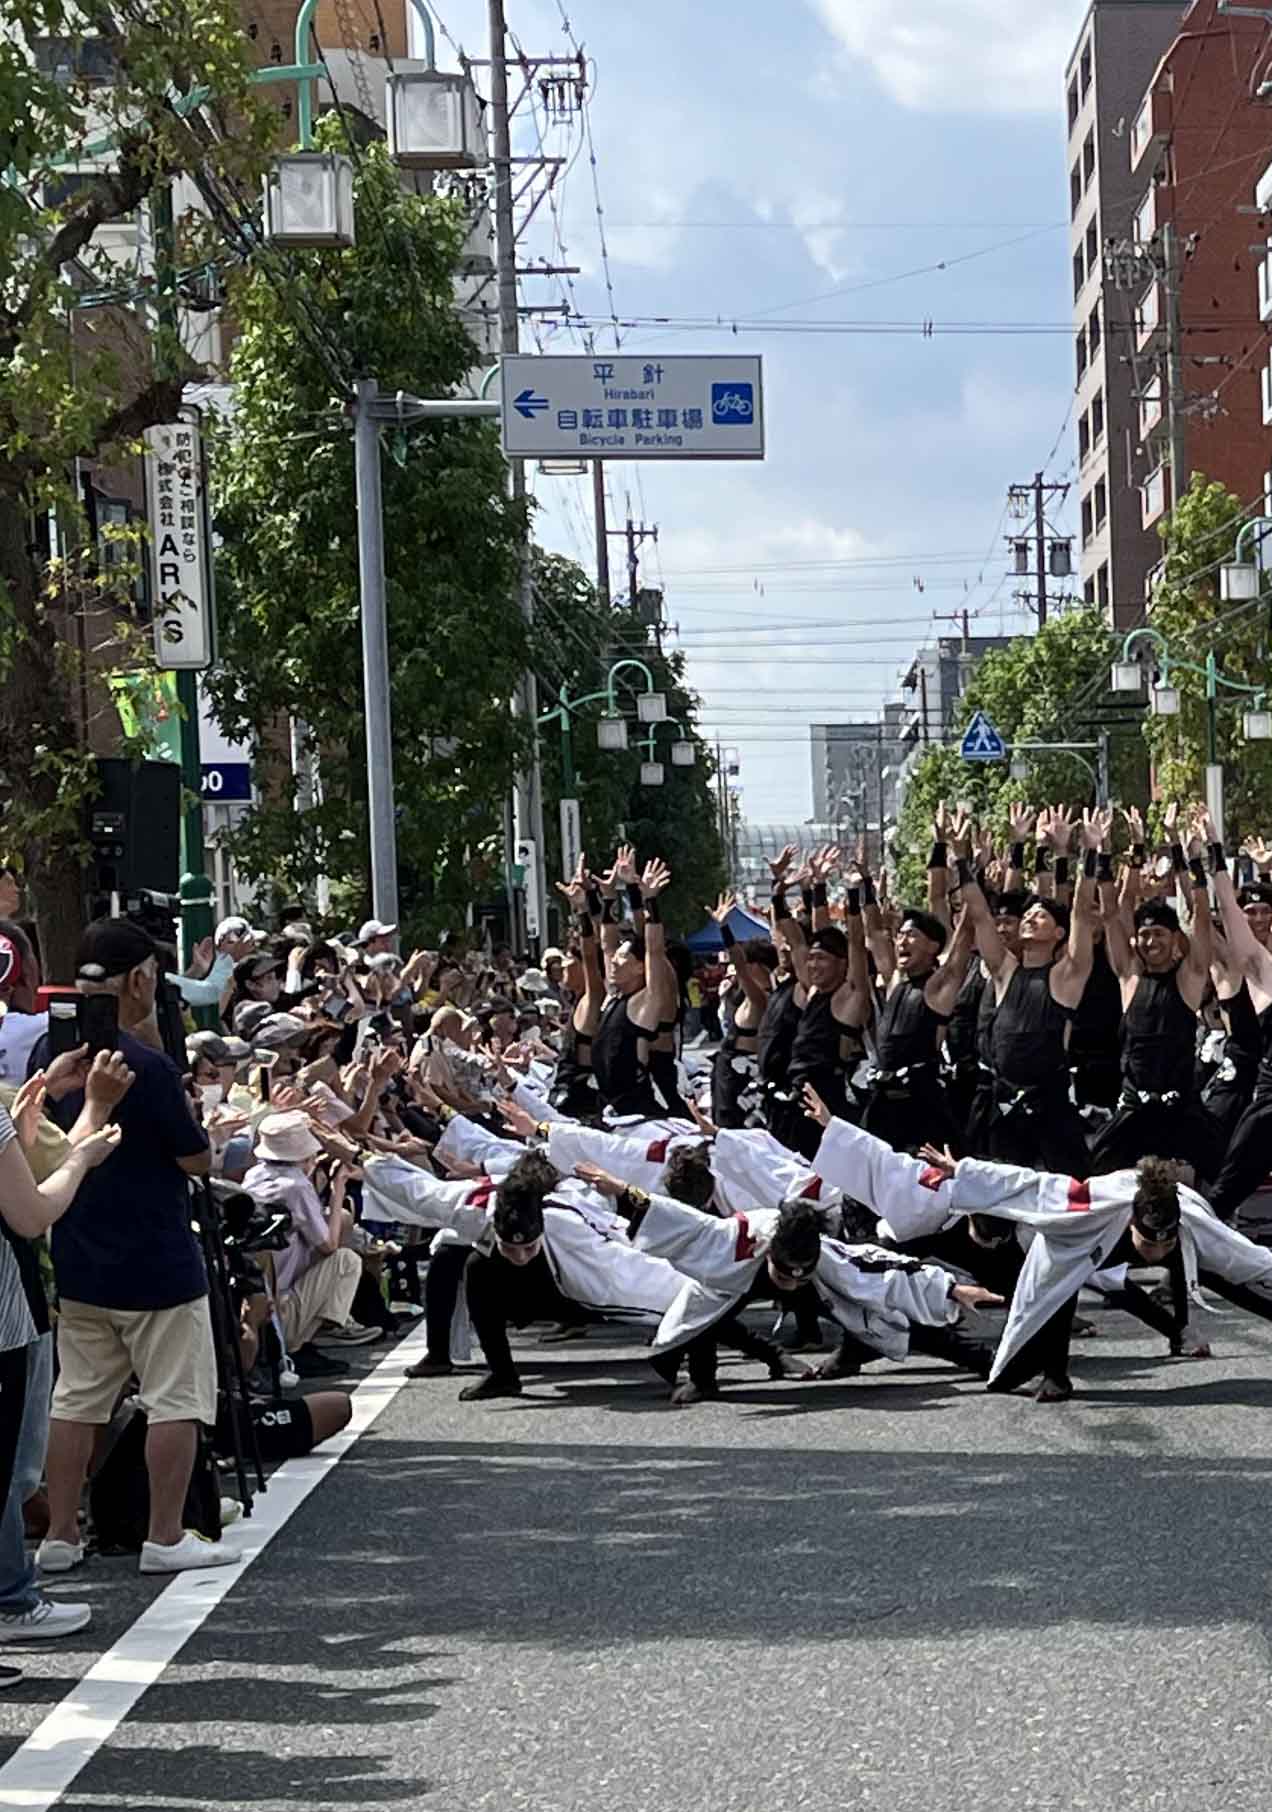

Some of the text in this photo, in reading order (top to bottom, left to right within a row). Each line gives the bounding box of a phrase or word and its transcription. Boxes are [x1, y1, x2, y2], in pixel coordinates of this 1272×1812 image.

[593, 363, 664, 385] 平針
[604, 388, 655, 400] Hirabari
[558, 408, 703, 430] 自転車駐車場
[580, 433, 682, 446] Bicycle Parking
